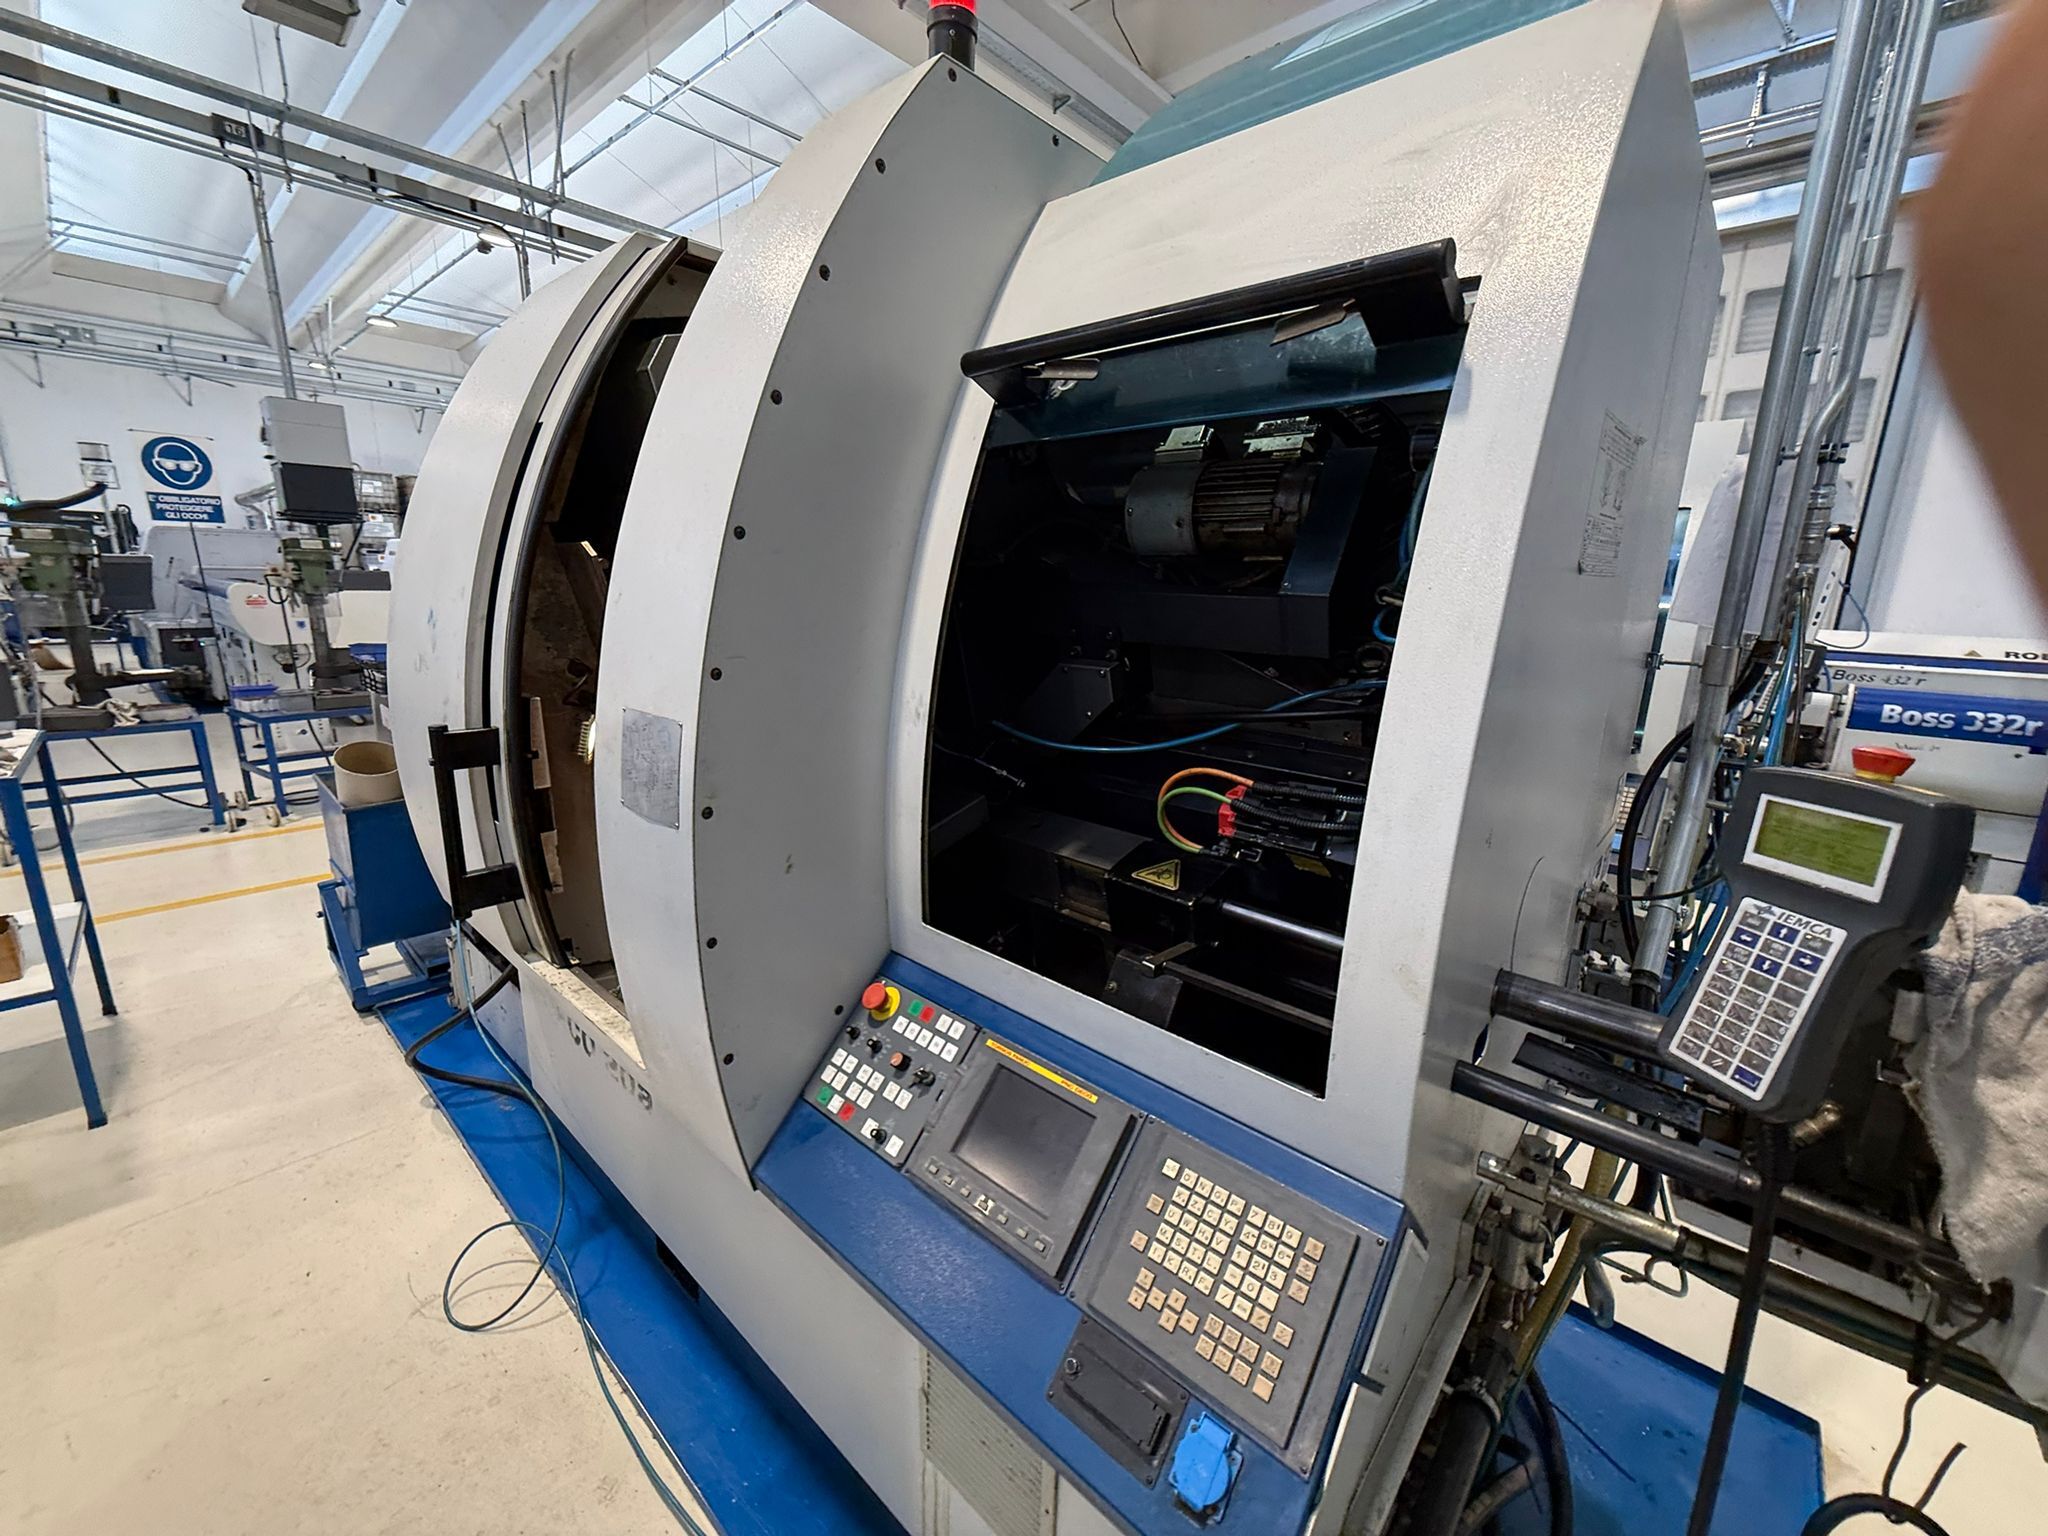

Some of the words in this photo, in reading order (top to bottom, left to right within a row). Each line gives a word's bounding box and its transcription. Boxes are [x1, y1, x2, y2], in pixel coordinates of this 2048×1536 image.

[158, 495, 221, 506] OBBLIGATORIO
[156, 503, 214, 513] PROTEGGERE
[165, 511, 180, 519] GLI
[181, 512, 209, 520] OCCHI
[1832, 669, 1877, 682] Boss
[1880, 703, 1956, 729] Boss
[1962, 710, 2044, 737] 332r
[1777, 911, 1833, 939] IEMCA
